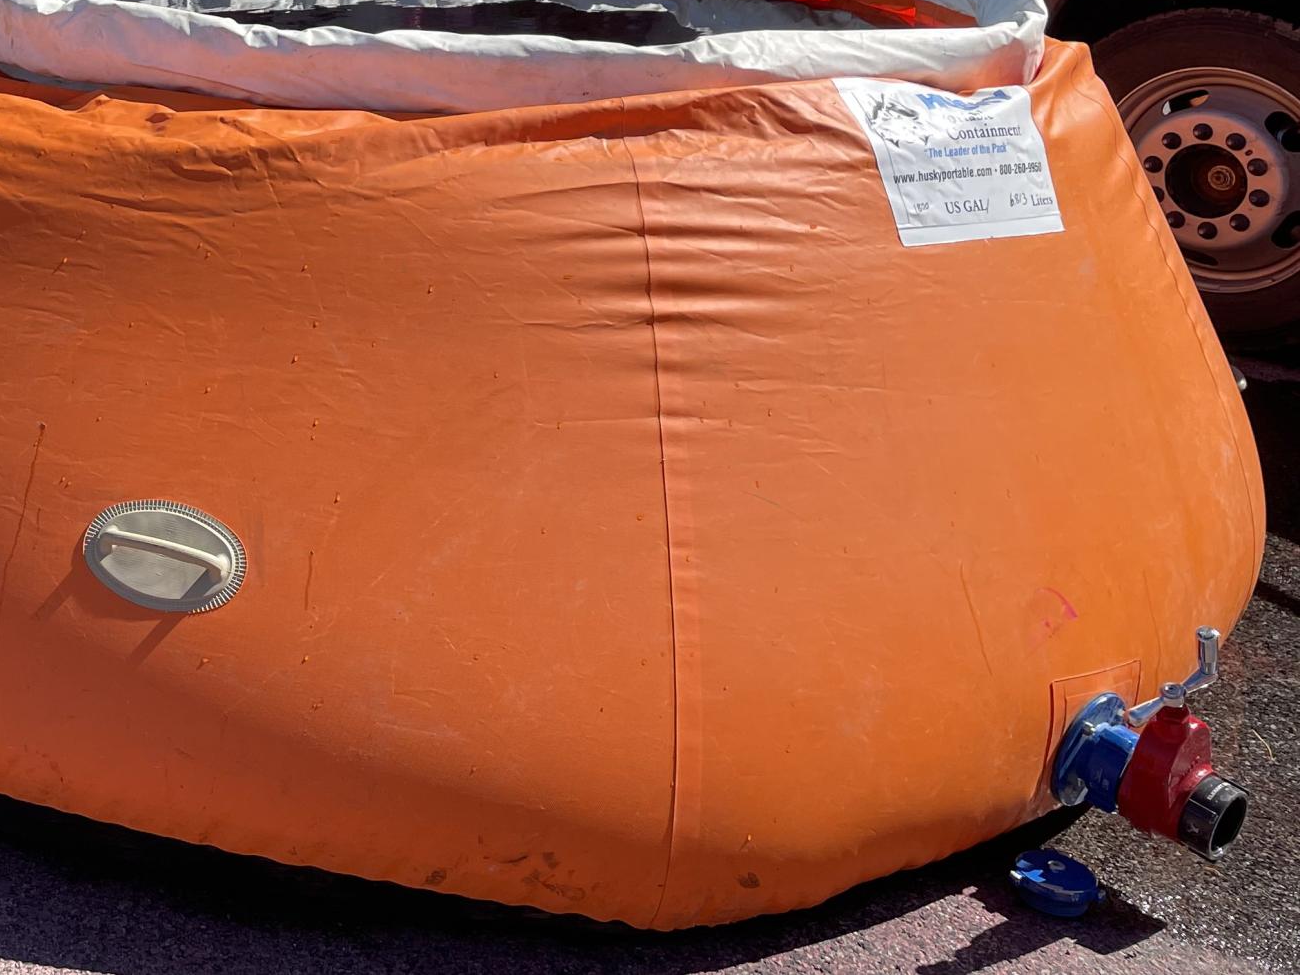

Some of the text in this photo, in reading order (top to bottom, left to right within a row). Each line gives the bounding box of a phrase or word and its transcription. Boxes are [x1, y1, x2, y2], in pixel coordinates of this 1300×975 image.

[944, 145, 970, 157] Leader
[971, 144, 979, 155] of
[893, 166, 993, 184] www.huskyportable.com
[945, 200, 961, 214] US
